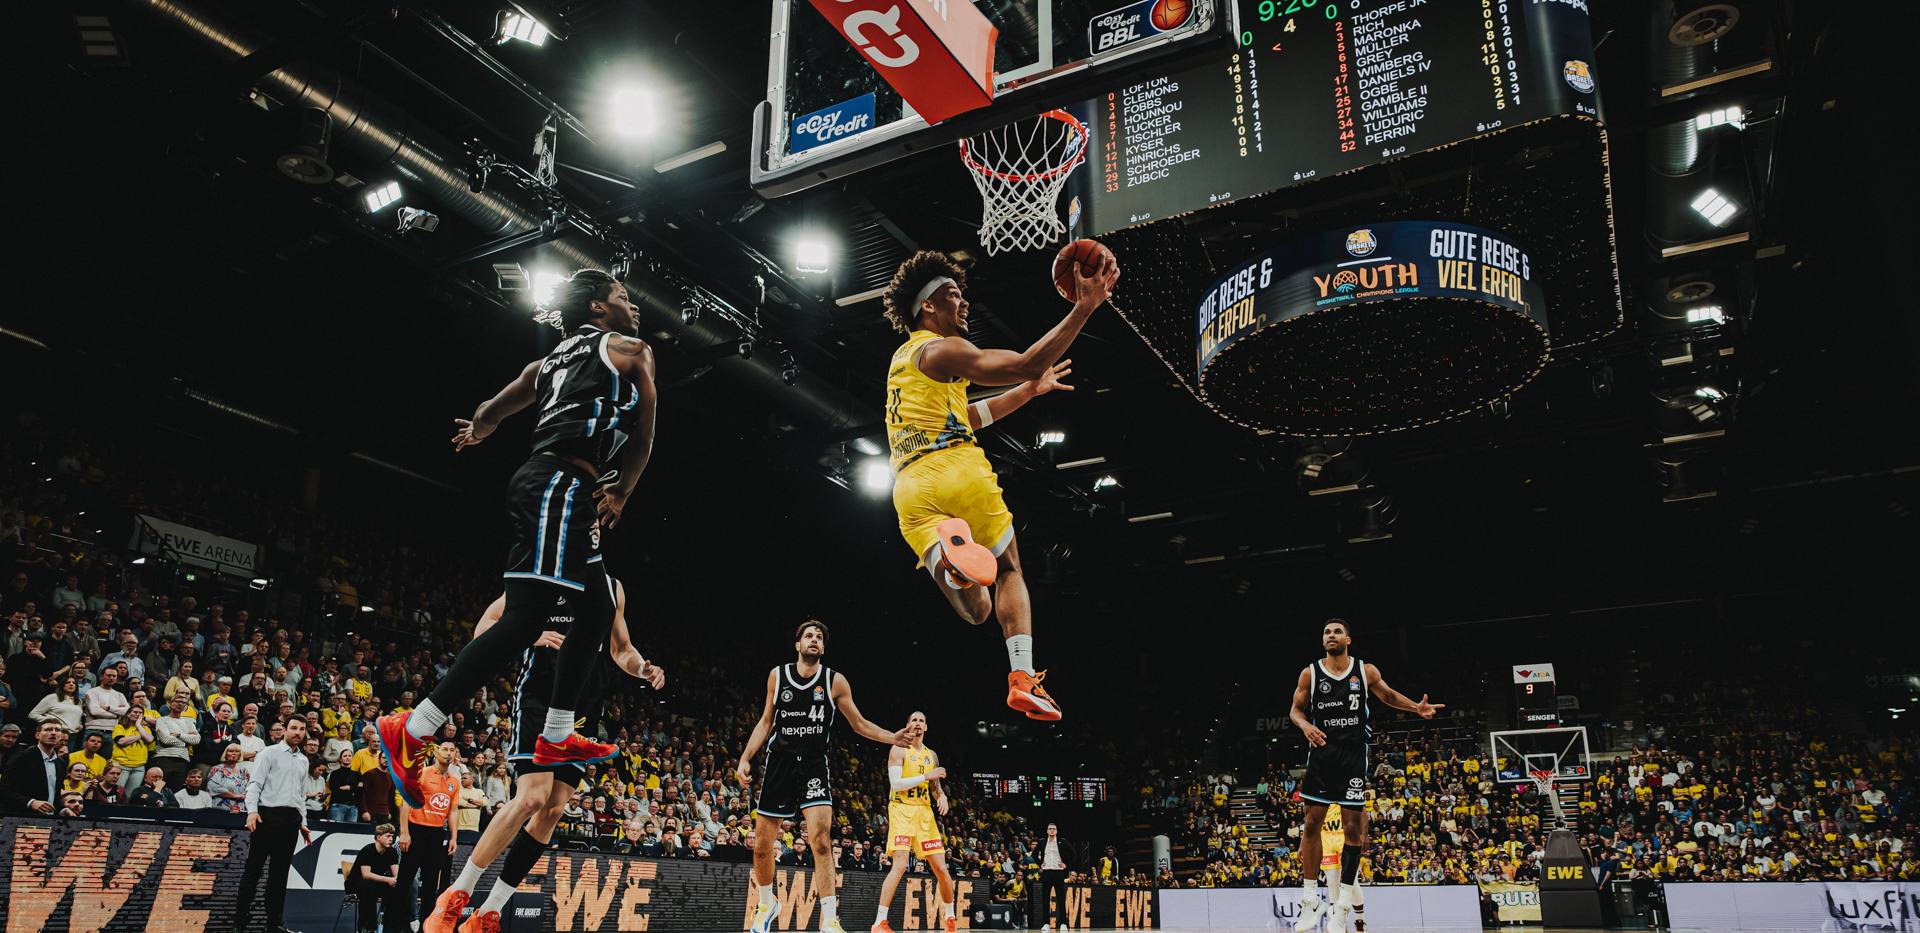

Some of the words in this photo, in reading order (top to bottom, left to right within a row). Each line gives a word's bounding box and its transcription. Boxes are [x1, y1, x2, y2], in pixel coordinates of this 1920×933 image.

[1098, 25, 1141, 50] BBL
[1283, 18, 1297, 32] 4
[1336, 22, 1343, 32] 2
[1351, 0, 1406, 25] THORPE
[1336, 32, 1344, 42] 3
[1353, 19, 1384, 36] RICH
[1338, 43, 1345, 52] 5
[1354, 20, 1421, 46] MARONKA
[1339, 53, 1346, 62] 6
[1355, 33, 1409, 57] MÜLLER
[1483, 9, 1491, 18] 0
[1499, 4, 1508, 13] 0
[1334, 74, 1348, 85] 17
[1357, 52, 1423, 78] WIMBERG
[1486, 30, 1495, 40] 8
[1502, 26, 1511, 36] 2
[1335, 85, 1348, 97] 21
[1359, 65, 1416, 89] DANIELS
[1418, 60, 1432, 72] IV
[1481, 42, 1496, 54] 11
[1504, 37, 1512, 47] 0
[1340, 64, 1347, 73] 8
[1356, 48, 1393, 67] GREY
[1485, 20, 1493, 29] 0
[1501, 14, 1508, 24] 1
[1108, 92, 1115, 101] 0
[1232, 54, 1240, 63] 9
[1248, 49, 1254, 58] 1
[1109, 102, 1115, 111] 3
[1123, 82, 1179, 106] CLEMONS
[1227, 64, 1241, 75] 14
[1249, 59, 1256, 69] 3
[1109, 112, 1116, 120] 4
[1124, 98, 1162, 116] FOBBS
[1234, 74, 1241, 84] 9
[1250, 69, 1256, 79] 1
[1336, 96, 1351, 108] 25
[1360, 81, 1398, 100] OGBE
[1482, 53, 1498, 65] 12
[1506, 49, 1513, 58] 1
[1337, 107, 1351, 119] 27
[1361, 88, 1417, 111] GAMBLE
[1420, 85, 1428, 95] II
[1491, 64, 1500, 75] 0
[1507, 60, 1516, 70] 0
[1339, 118, 1354, 130] 34
[1362, 96, 1427, 122] WILLIAMS
[1493, 76, 1502, 86] 3
[1509, 71, 1518, 82] 3
[816, 113, 869, 142] Credit
[1105, 142, 1116, 151] 11
[1125, 122, 1181, 145] TISCHLER
[1236, 104, 1244, 114] 8
[1252, 100, 1259, 109] 4
[1110, 122, 1116, 130] 5
[1124, 101, 1183, 126] HOUNNOU
[1235, 84, 1242, 94] 3
[1250, 79, 1258, 89] 2
[1110, 131, 1116, 140] 7
[1125, 115, 1172, 135] TUCKER
[1235, 94, 1243, 103] 0
[1252, 90, 1258, 99] 1
[1340, 129, 1355, 140] 44
[1364, 110, 1424, 133] TUDURIC
[1494, 88, 1503, 98] 2
[1511, 83, 1520, 93] 3
[1341, 140, 1356, 152] 52
[1365, 123, 1416, 146] PERRIN
[1496, 99, 1505, 110] 5
[1513, 95, 1520, 105] 1
[1105, 162, 1117, 173] 21
[1126, 144, 1180, 166] HINRICHS
[1238, 126, 1246, 136] 0
[1254, 122, 1262, 131] 2
[1106, 152, 1117, 162] 12
[1126, 137, 1164, 156] KYSER
[1232, 115, 1244, 126] 11
[1253, 110, 1260, 120] 1
[1106, 173, 1118, 183] 29
[1127, 149, 1201, 176] SCHROEDER
[1239, 137, 1246, 146] 0
[1255, 132, 1262, 142] 1
[1106, 183, 1119, 193] 33
[1128, 168, 1169, 187] ZUBCIC
[1240, 148, 1247, 157] 8
[1256, 142, 1262, 152] 1
[1430, 228, 1477, 261] GUTE
[1482, 236, 1520, 276] REISE
[1438, 259, 1476, 290] VIEL
[1219, 264, 1257, 312] REISE
[1260, 257, 1273, 289] &
[203, 544, 252, 568] ARENA
[808, 705, 825, 722] 44
[1526, 684, 1534, 694] 9
[1527, 714, 1556, 722] SENGER
[1548, 866, 1584, 880] EWE
[1116, 890, 1152, 928] EWE
